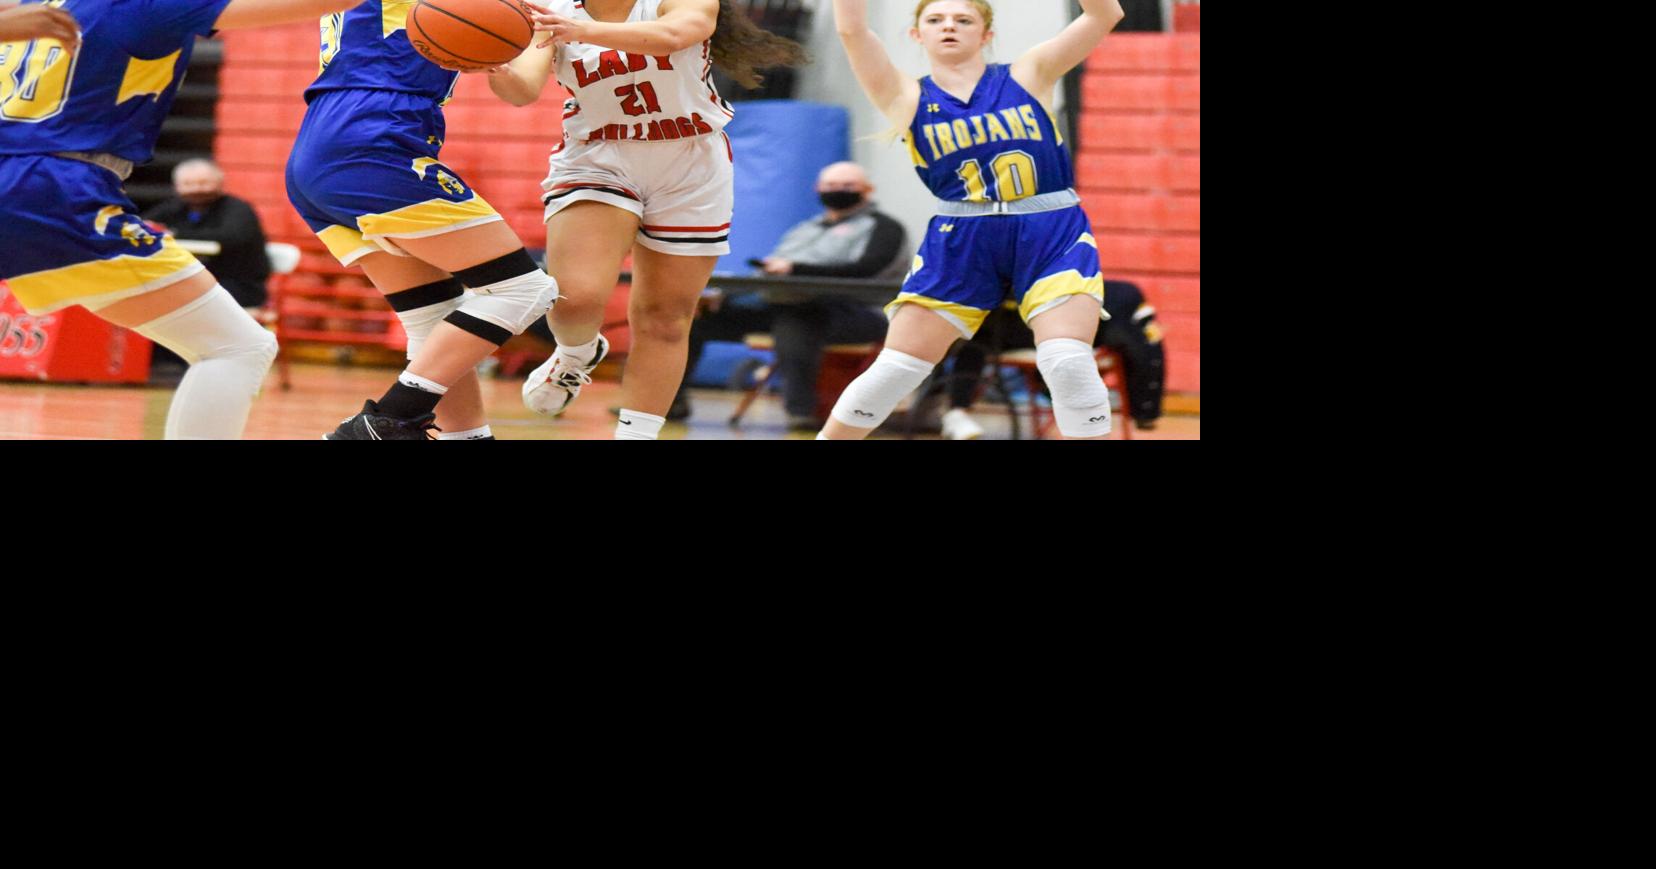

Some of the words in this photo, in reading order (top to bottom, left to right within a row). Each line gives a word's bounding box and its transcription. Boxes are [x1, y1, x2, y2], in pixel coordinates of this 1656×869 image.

[571, 49, 674, 88] LADY
[614, 80, 662, 117] 21
[922, 104, 1043, 161] TROJANS
[956, 149, 1038, 204] 10
